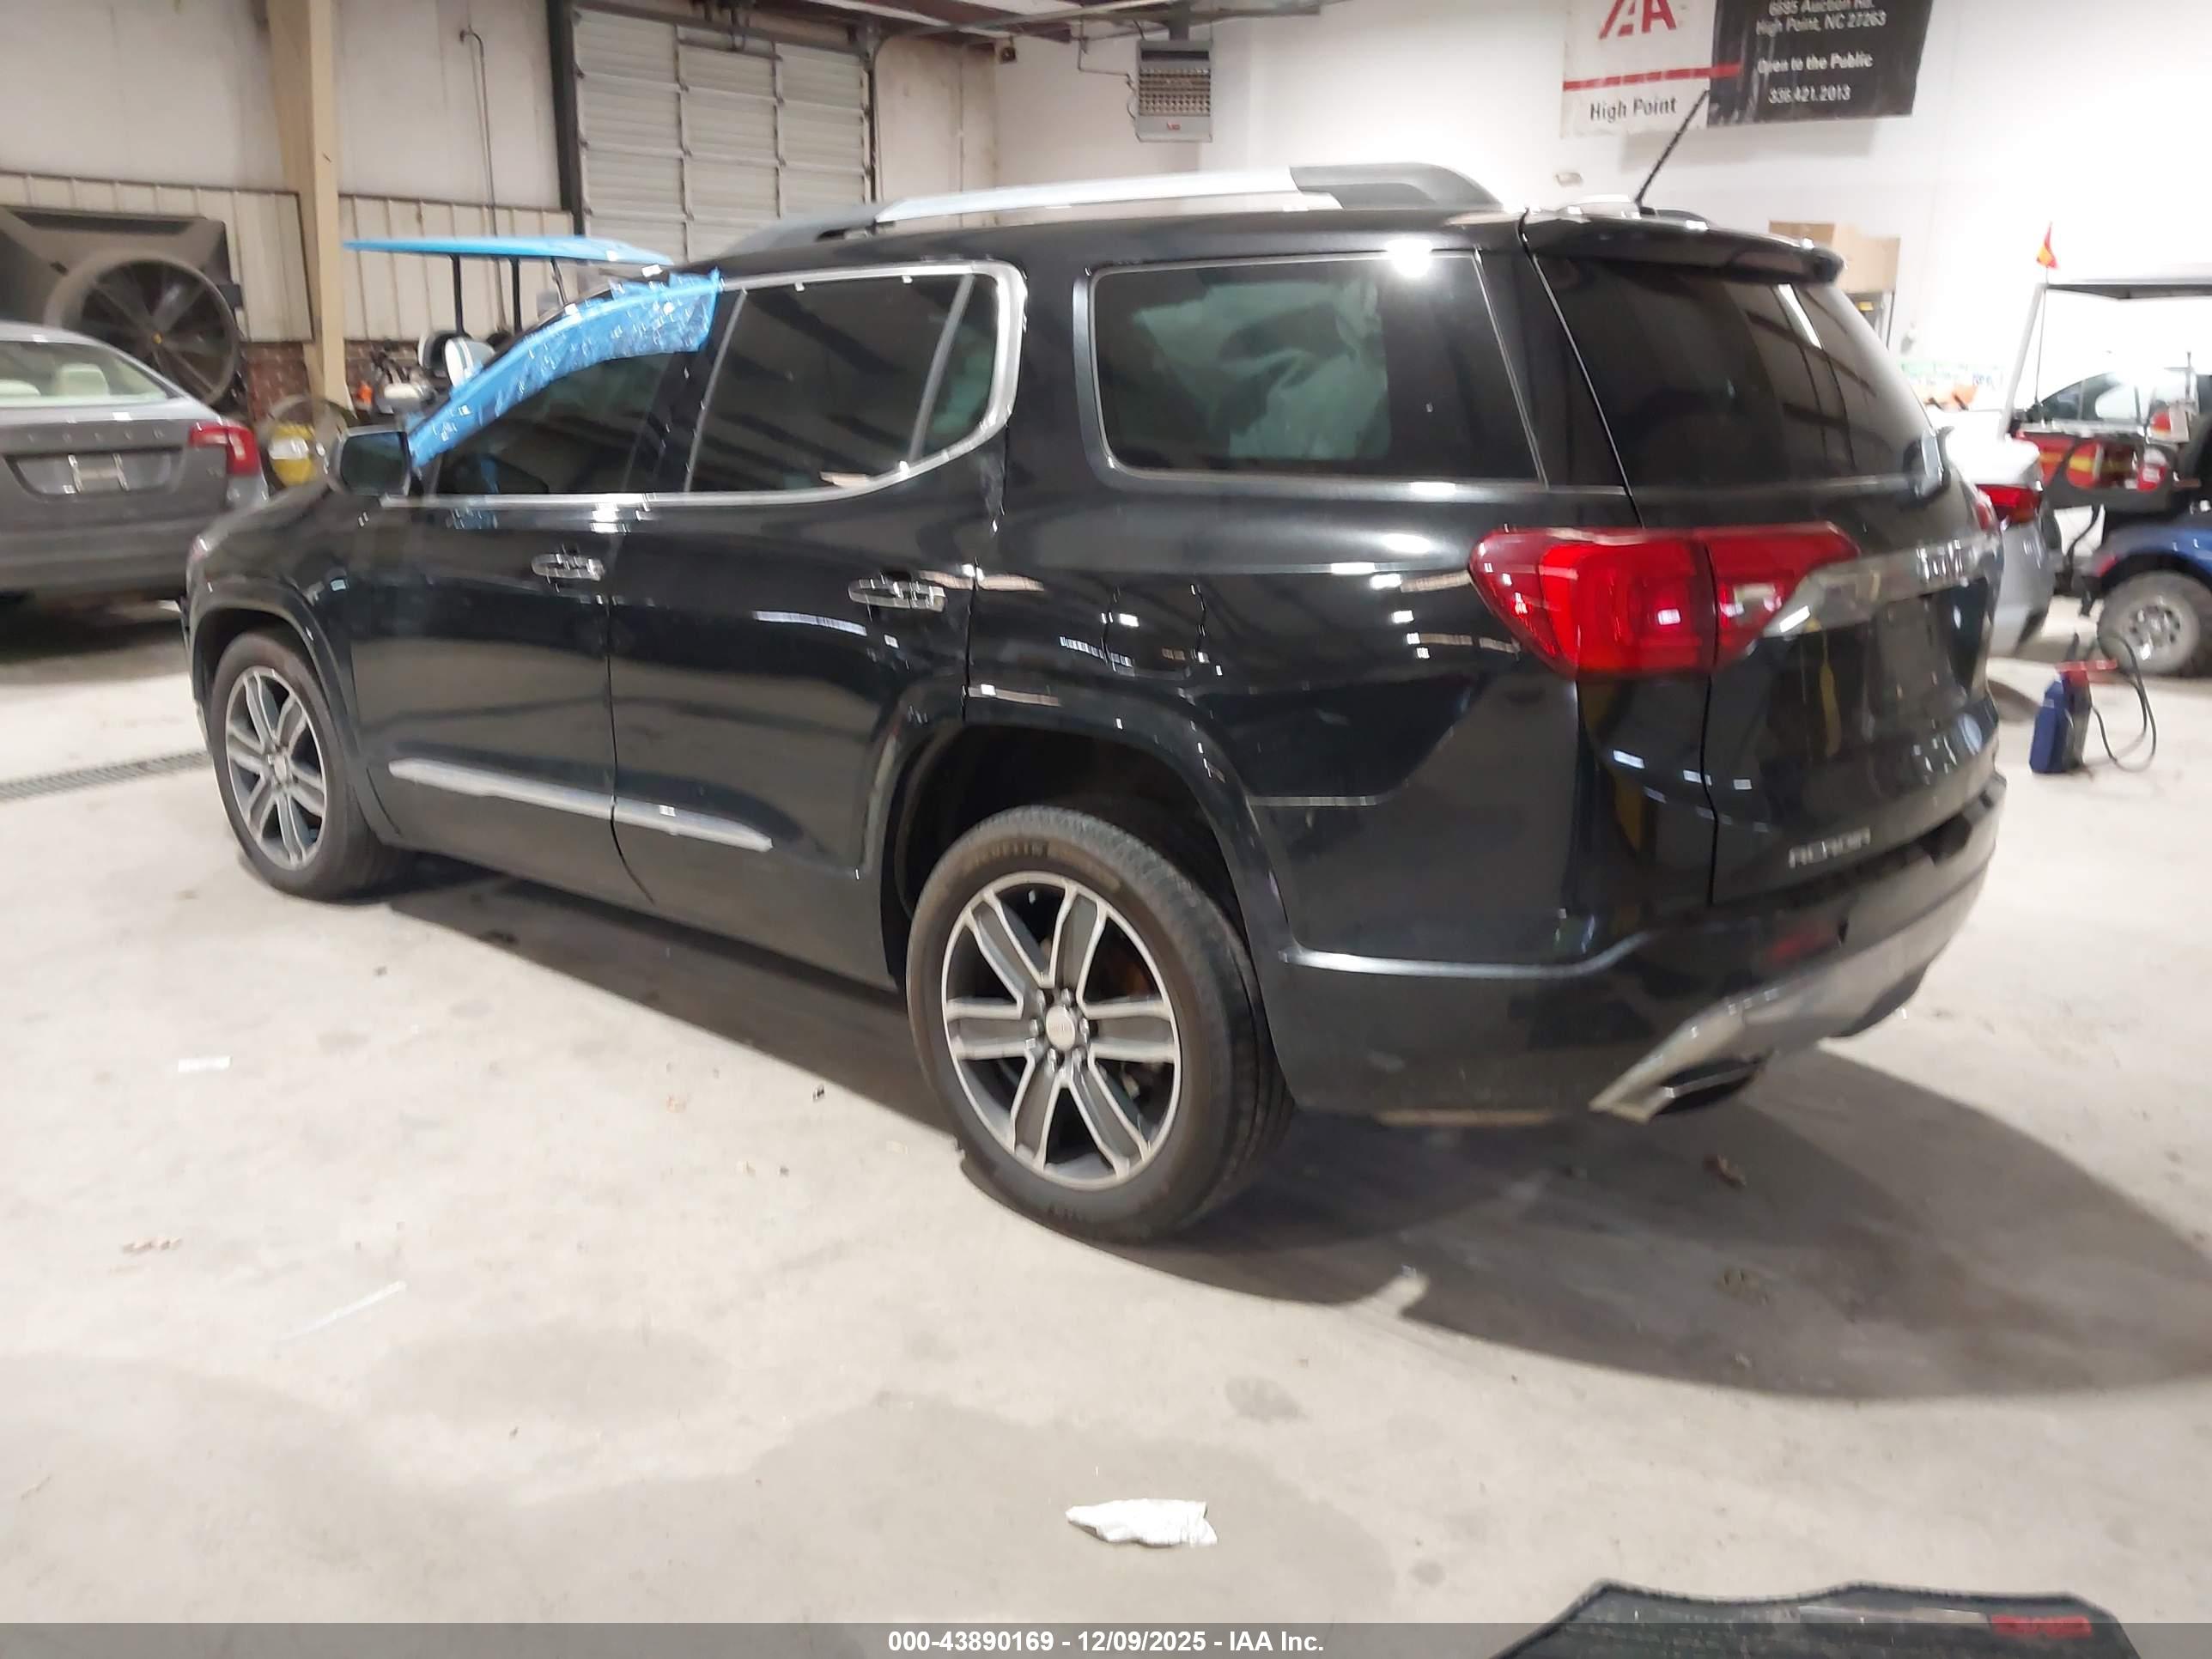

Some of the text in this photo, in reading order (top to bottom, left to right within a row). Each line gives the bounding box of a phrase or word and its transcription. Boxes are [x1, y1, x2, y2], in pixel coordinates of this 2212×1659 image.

[1824, 13, 1845, 29] NC
[1758, 51, 1875, 74] Open to the Public
[1589, 96, 1676, 124] High Point
